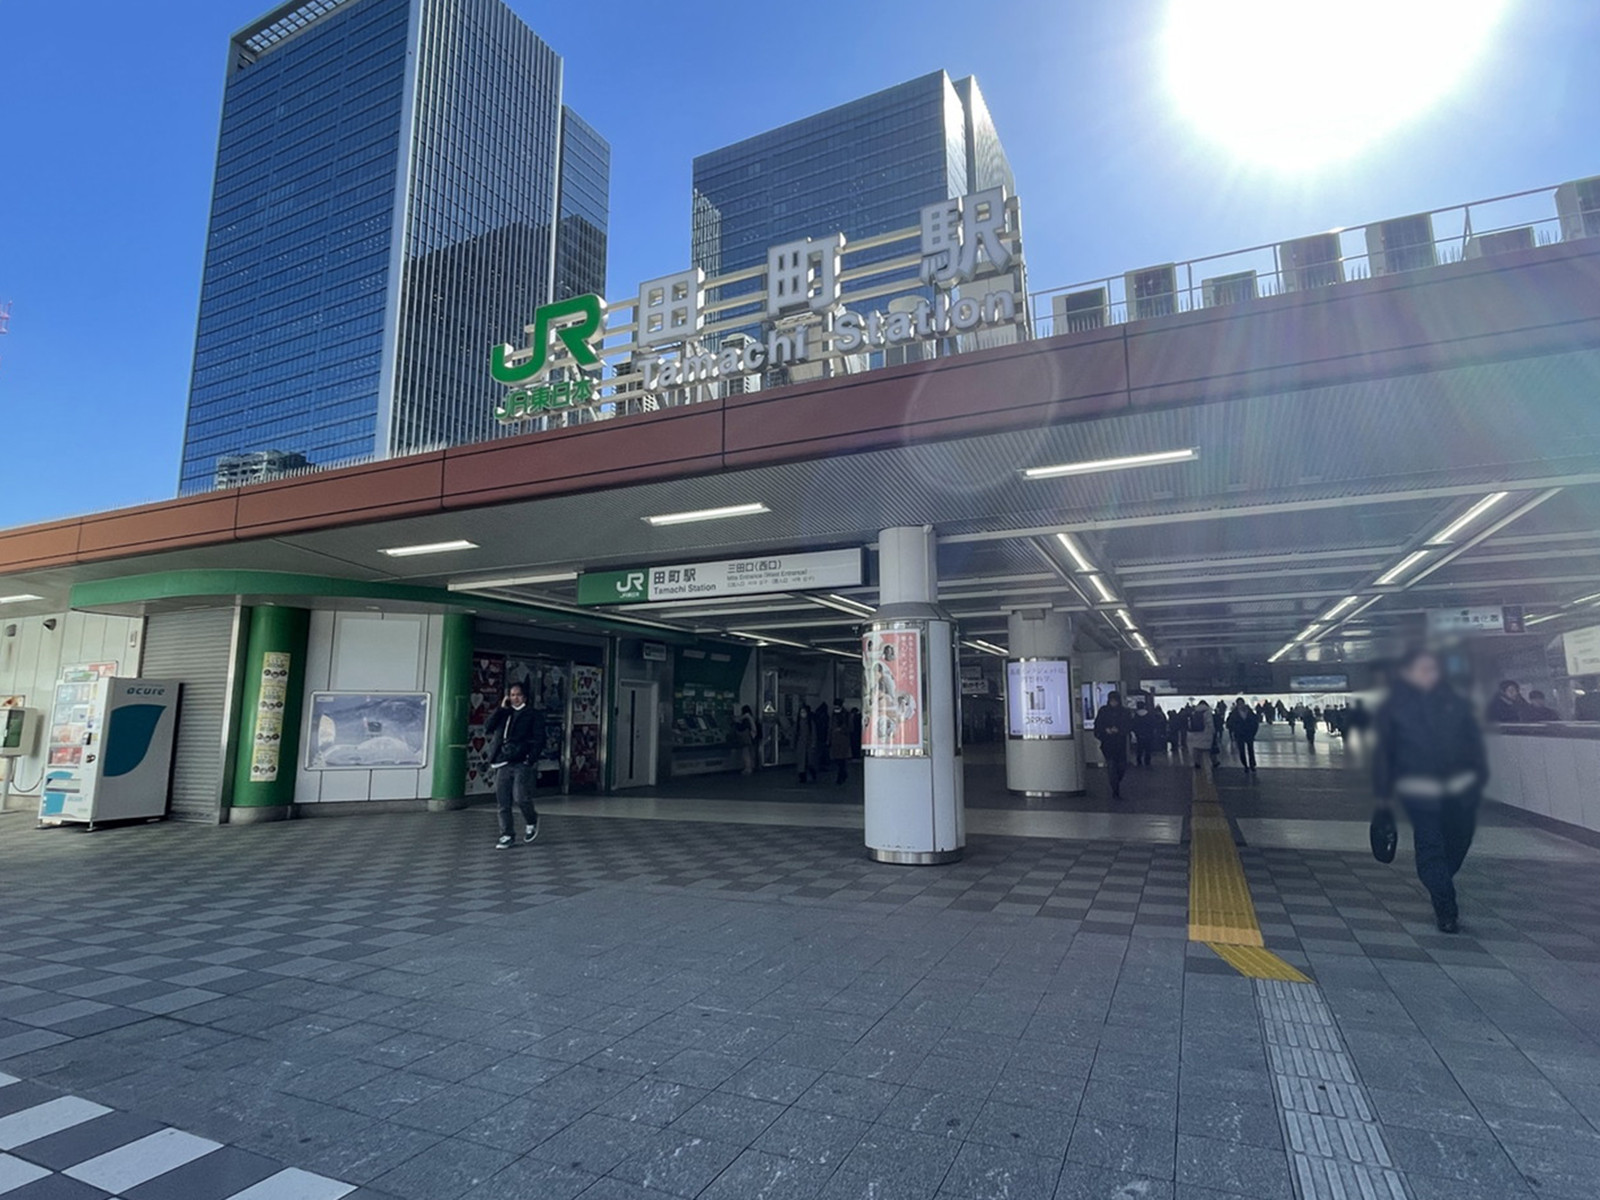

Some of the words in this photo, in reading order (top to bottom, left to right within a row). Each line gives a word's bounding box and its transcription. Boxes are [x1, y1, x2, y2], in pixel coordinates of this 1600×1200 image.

[491, 293, 605, 384] JR
[638, 324, 809, 391] Tamachi
[833, 288, 1015, 353] Station
[494, 379, 596, 421] JR東日本
[616, 572, 645, 593] JR
[653, 568, 697, 584] 田町駅
[654, 585, 687, 595] Tamachi
[688, 582, 717, 593] Station
[126, 686, 166, 696] acure
